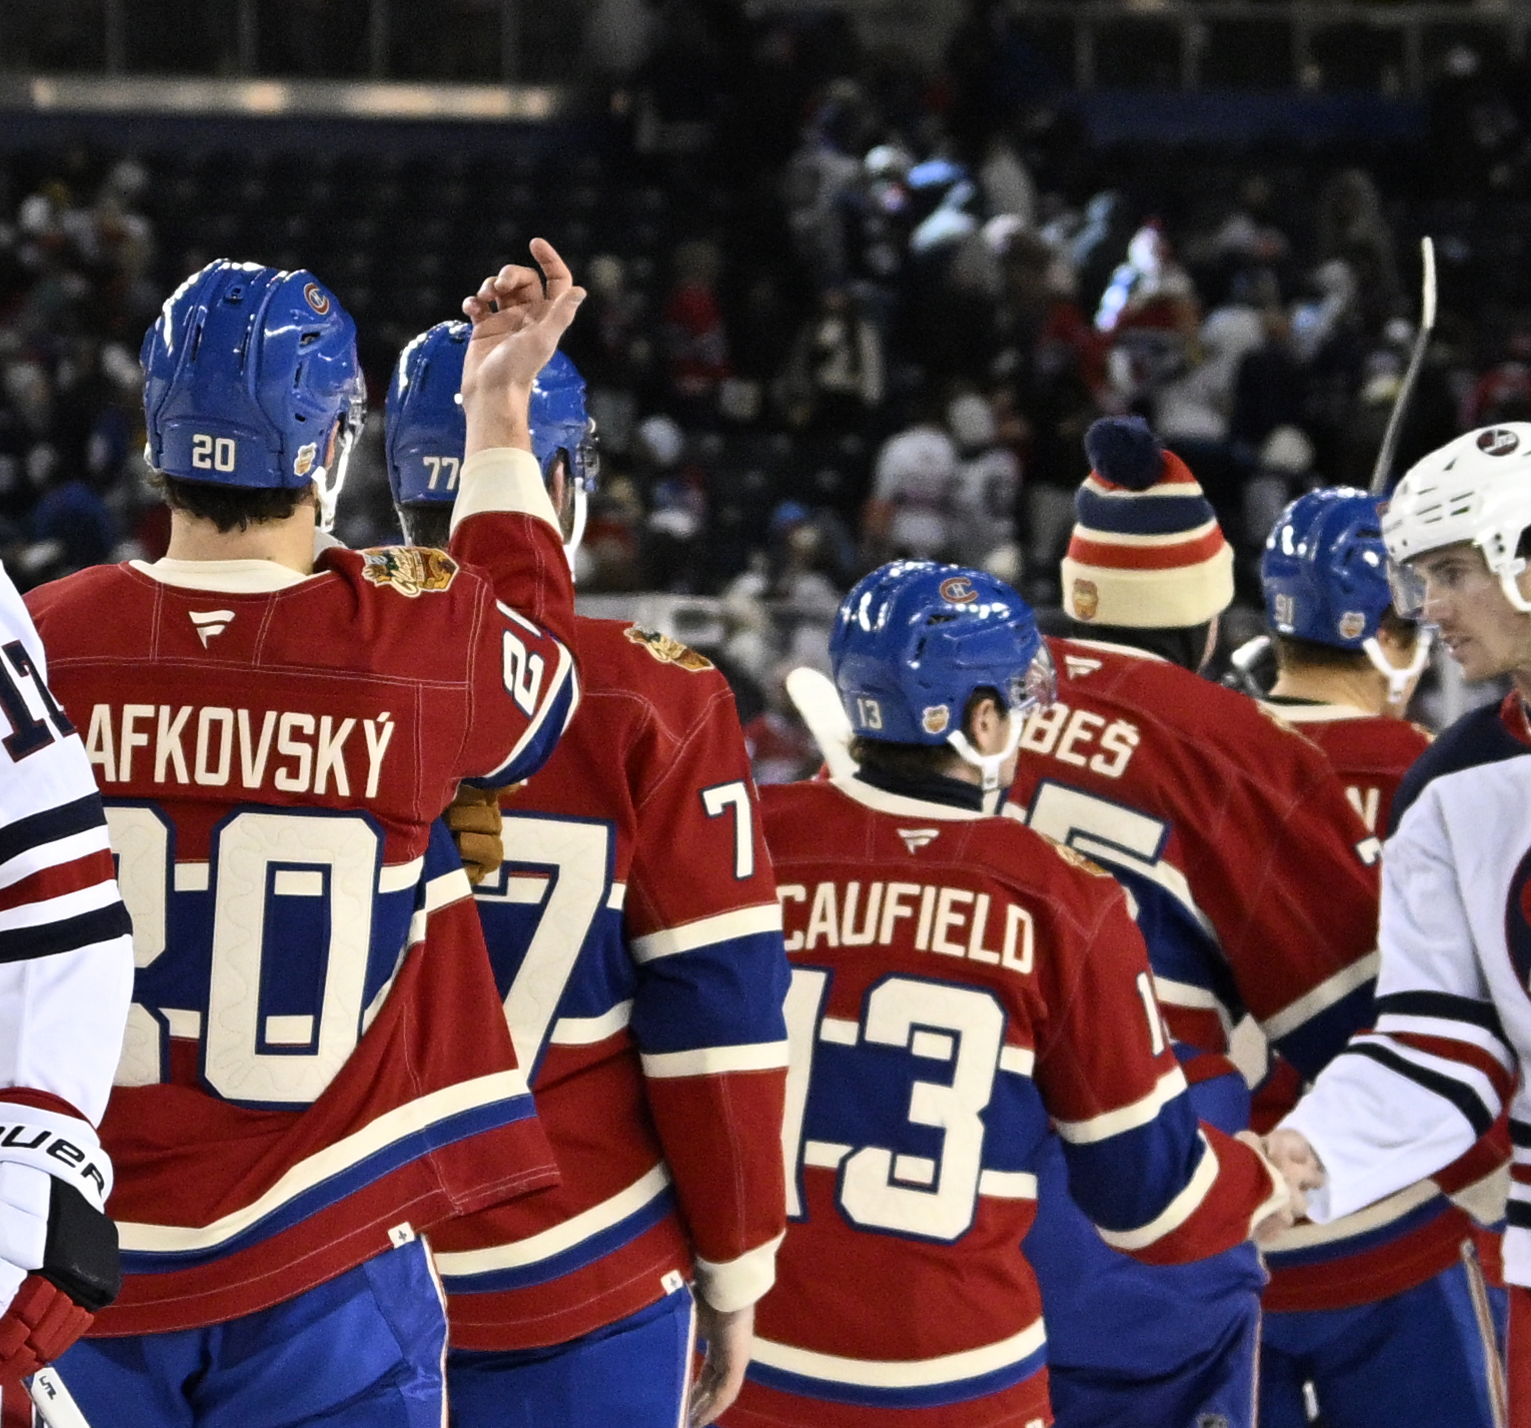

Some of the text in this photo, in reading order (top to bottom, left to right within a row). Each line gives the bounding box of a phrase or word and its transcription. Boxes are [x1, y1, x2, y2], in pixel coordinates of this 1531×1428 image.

[191, 433, 237, 473] 20
[422, 456, 460, 491] 77
[855, 697, 885, 732] 13
[1018, 701, 1140, 779] BEŠ
[85, 711, 395, 799] AFKOVSKÝ
[782, 882, 1035, 974] CAUFIELD
